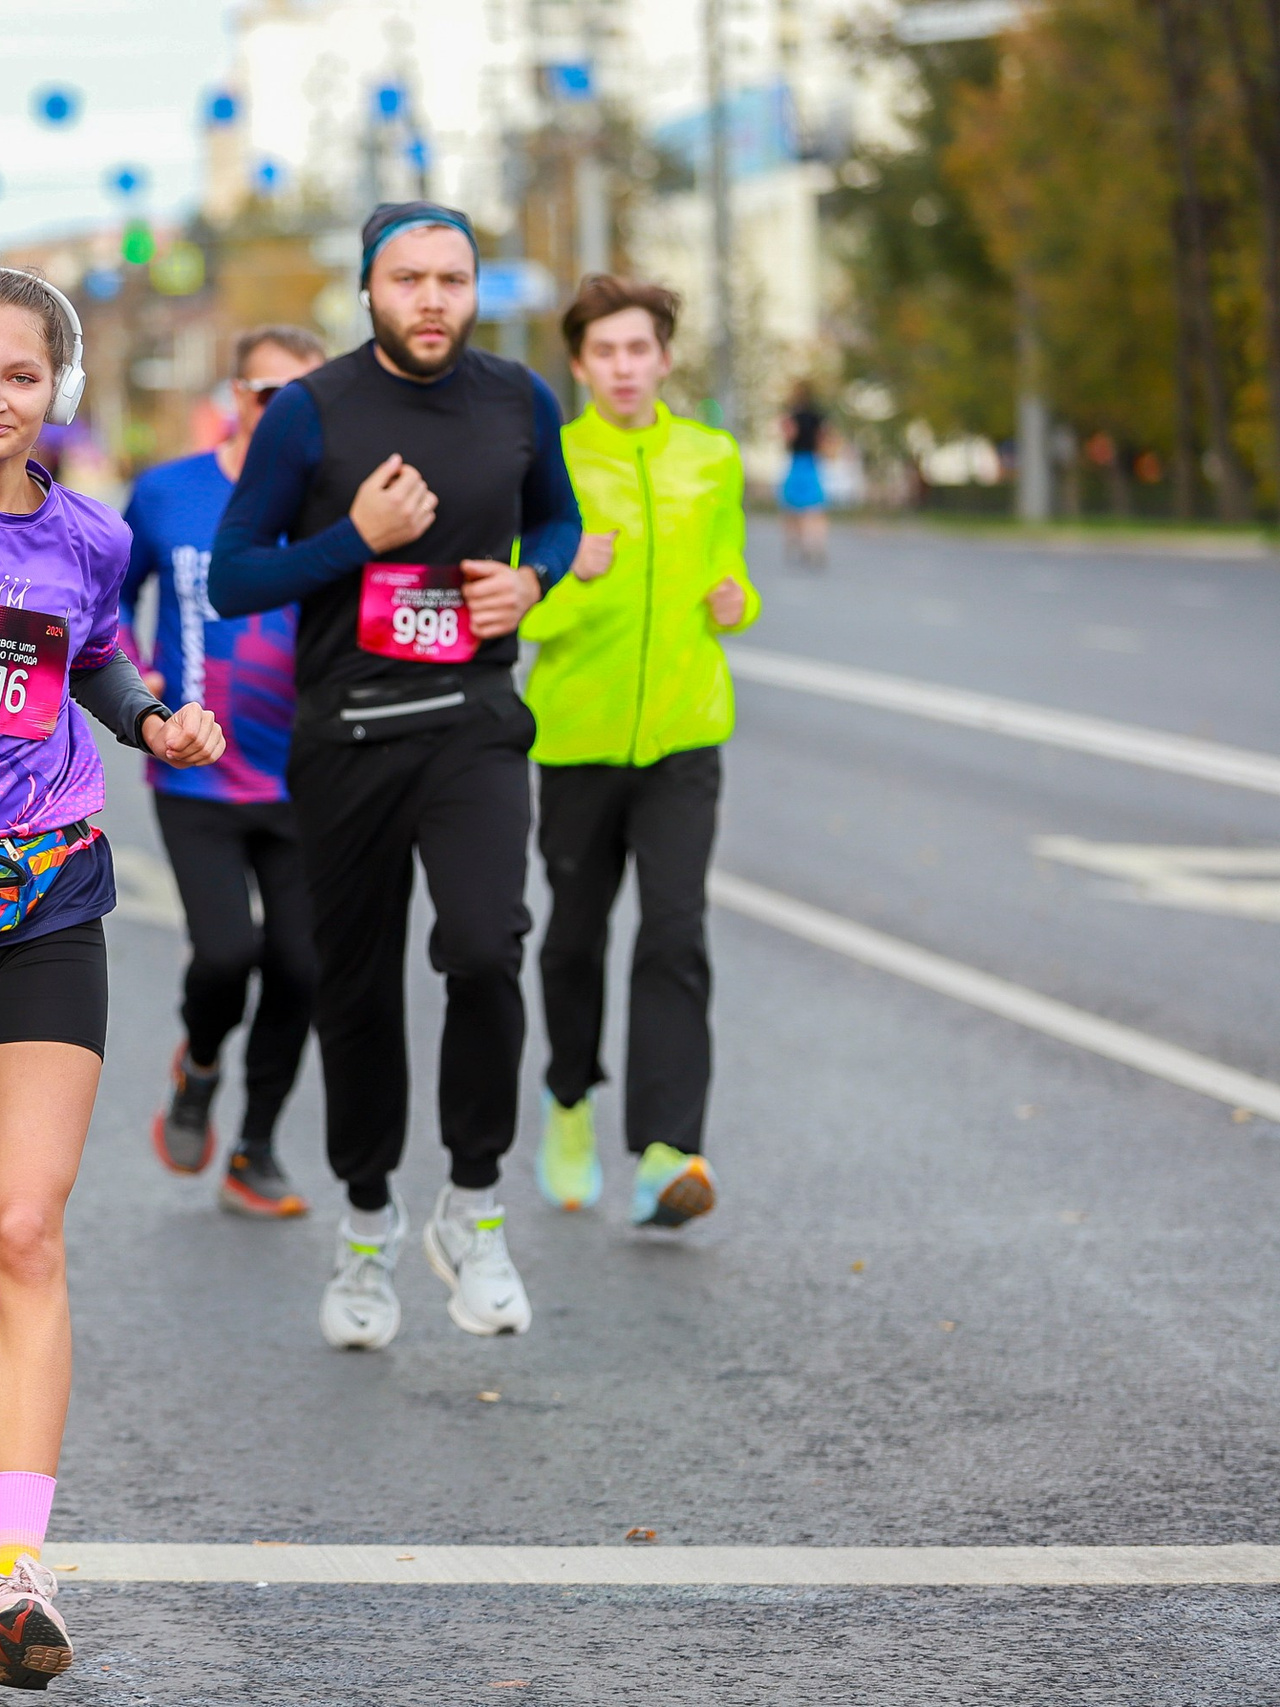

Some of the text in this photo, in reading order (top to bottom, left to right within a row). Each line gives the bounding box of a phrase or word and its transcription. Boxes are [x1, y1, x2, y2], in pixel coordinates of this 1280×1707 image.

[45, 625, 63, 638] 2024
[392, 606, 459, 647] 998
[8, 652, 38, 666] ГОРОДА
